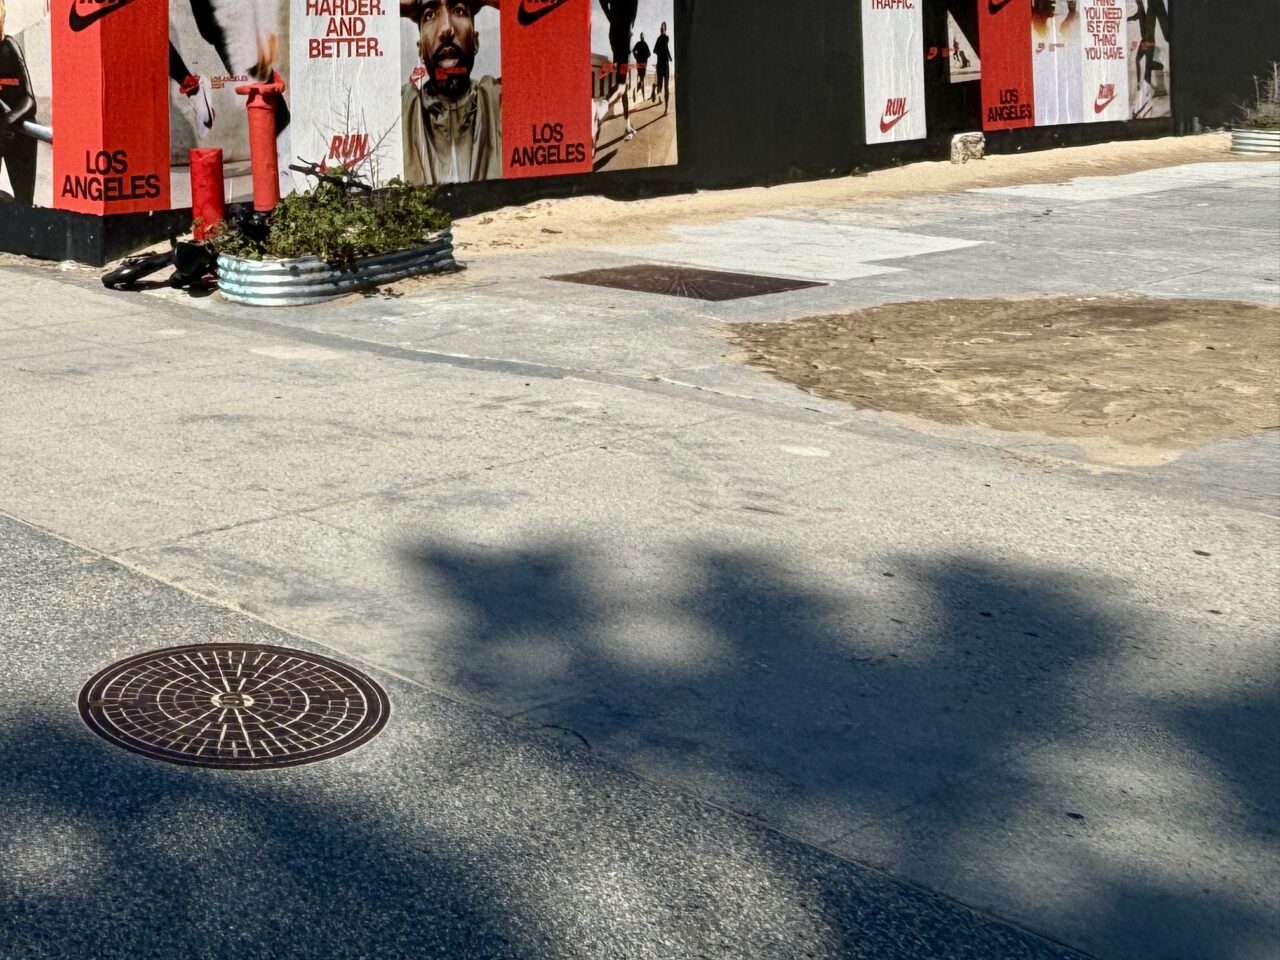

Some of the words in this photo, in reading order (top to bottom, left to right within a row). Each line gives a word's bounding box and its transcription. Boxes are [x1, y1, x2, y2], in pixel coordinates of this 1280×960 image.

[1084, 7, 1100, 19] YOU
[1102, 7, 1122, 19] NEED
[326, 17, 366, 37] AND
[308, 38, 384, 59] BETTER.
[1092, 34, 1117, 46] THING
[1084, 47, 1101, 60] YOU
[1000, 89, 1019, 104] LOS
[885, 98, 907, 116] RUN
[987, 104, 1032, 122] ANGELES
[532, 123, 564, 142] LOS
[329, 134, 369, 159] RUN
[510, 142, 586, 167] ANGELES
[85, 149, 128, 175] LOS
[61, 175, 161, 202] ANGELES
